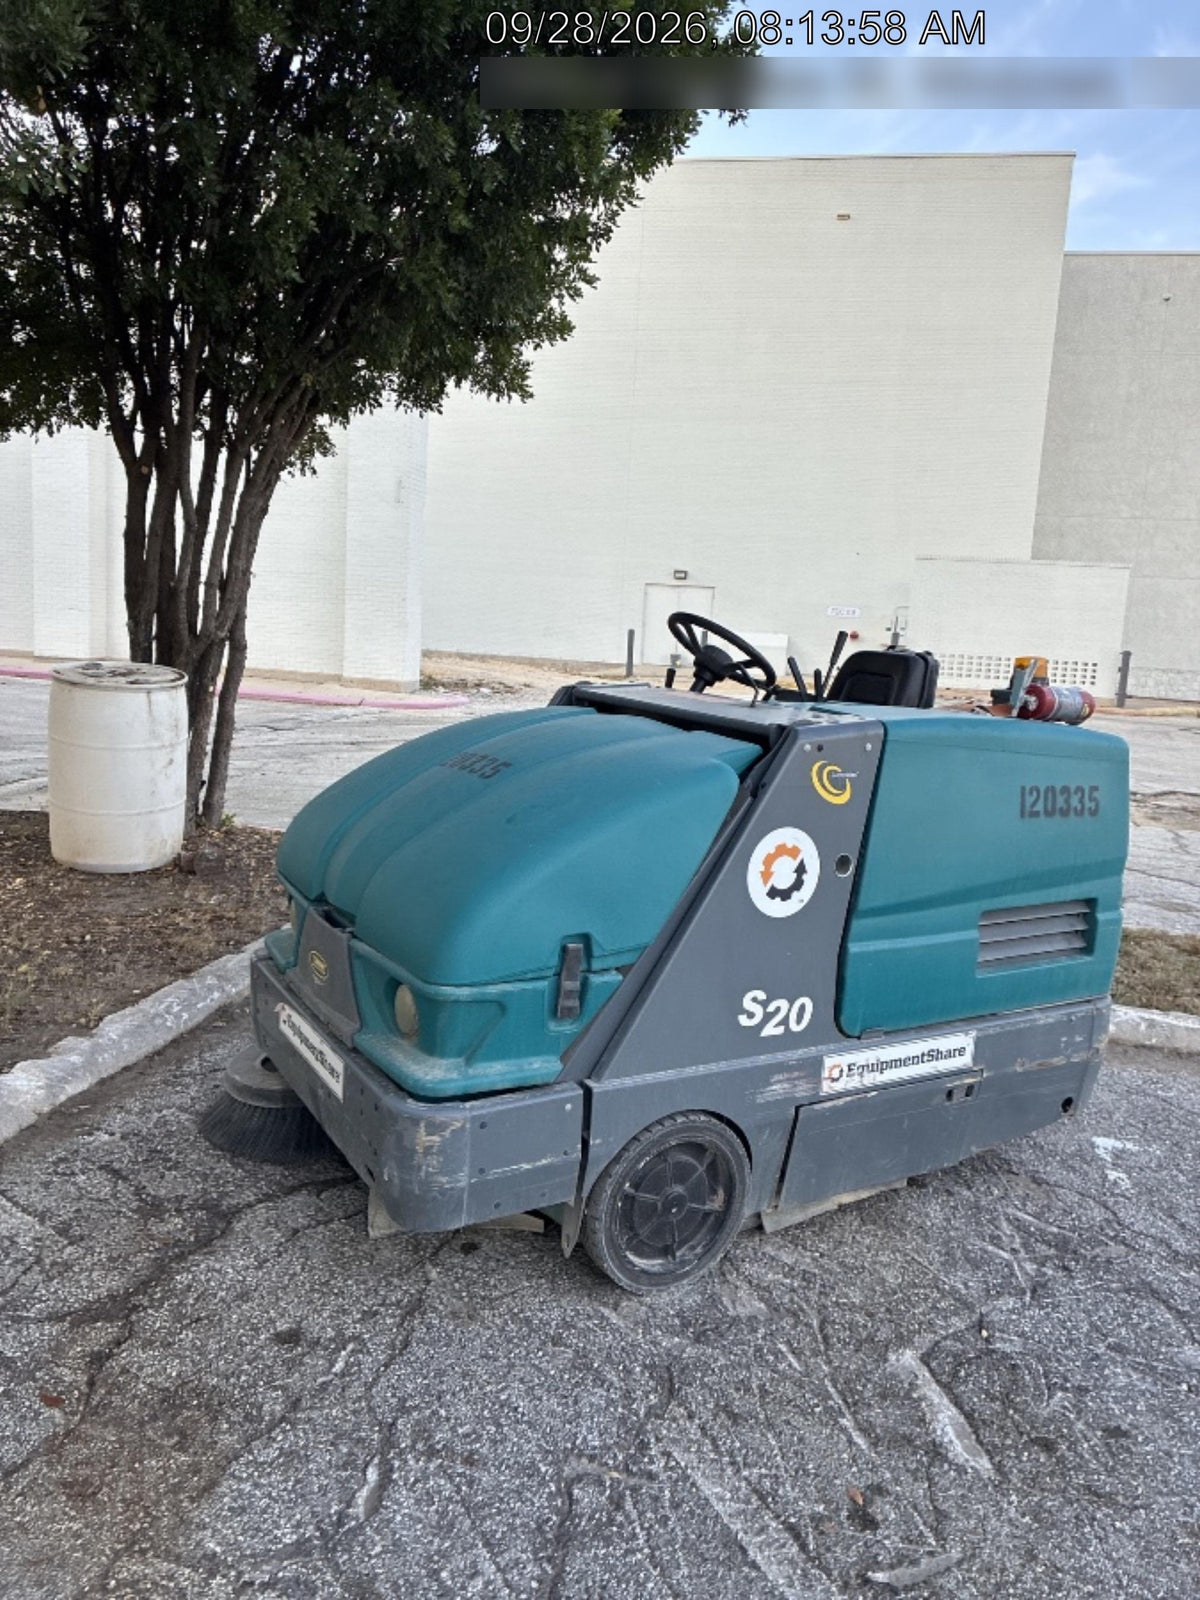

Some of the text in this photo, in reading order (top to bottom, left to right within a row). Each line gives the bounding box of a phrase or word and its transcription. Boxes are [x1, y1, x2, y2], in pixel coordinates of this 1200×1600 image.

[1020, 785, 1100, 819] 120335
[737, 989, 813, 1037] S20
[846, 1046, 967, 1078] EquipmentShare
